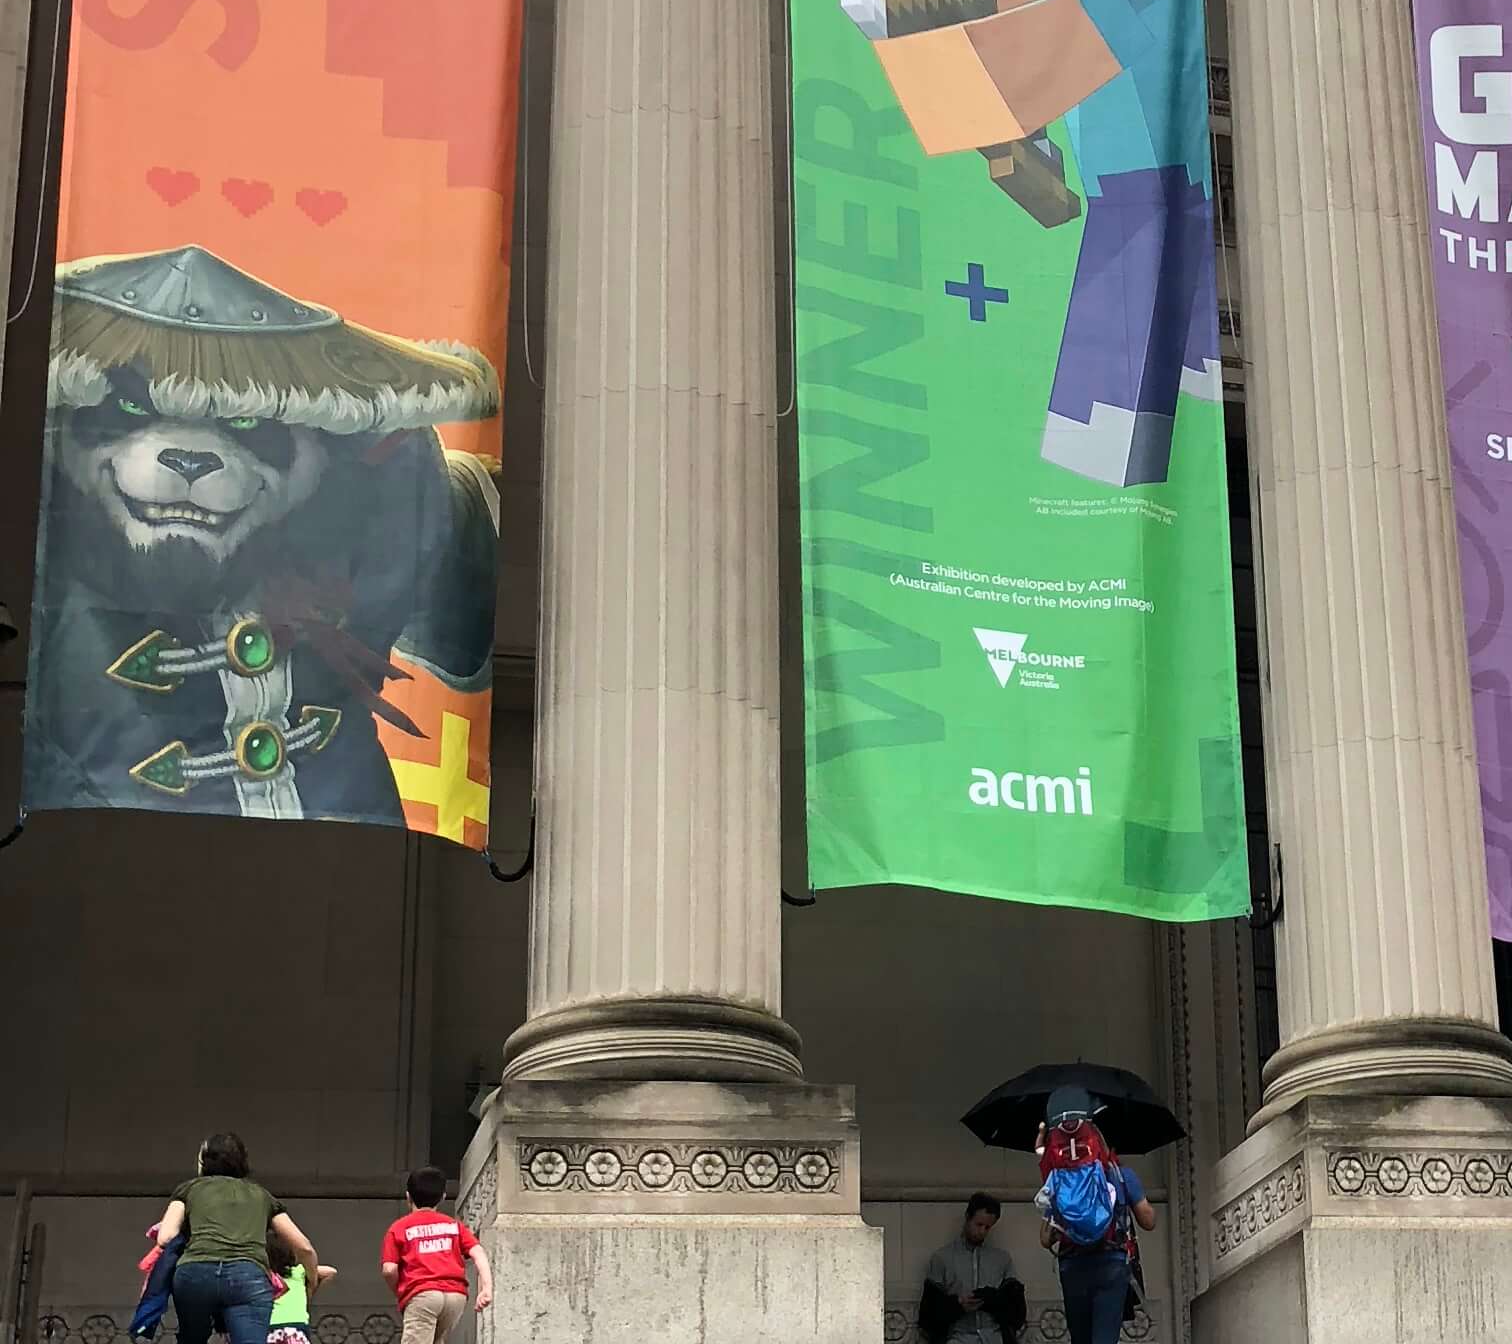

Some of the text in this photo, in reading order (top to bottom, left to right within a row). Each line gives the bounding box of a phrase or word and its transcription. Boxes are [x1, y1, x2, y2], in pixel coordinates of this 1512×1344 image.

[794, 75, 946, 765] WINNER
[889, 572, 1155, 614] (Australian Centre for the Moving Image)
[922, 562, 1127, 594] Exhibition developed by ACMI
[984, 647, 1086, 668] MELBOURNE
[1019, 669, 1054, 681] Victoria
[1019, 678, 1060, 689] Australia
[969, 766, 1093, 816] acmi
